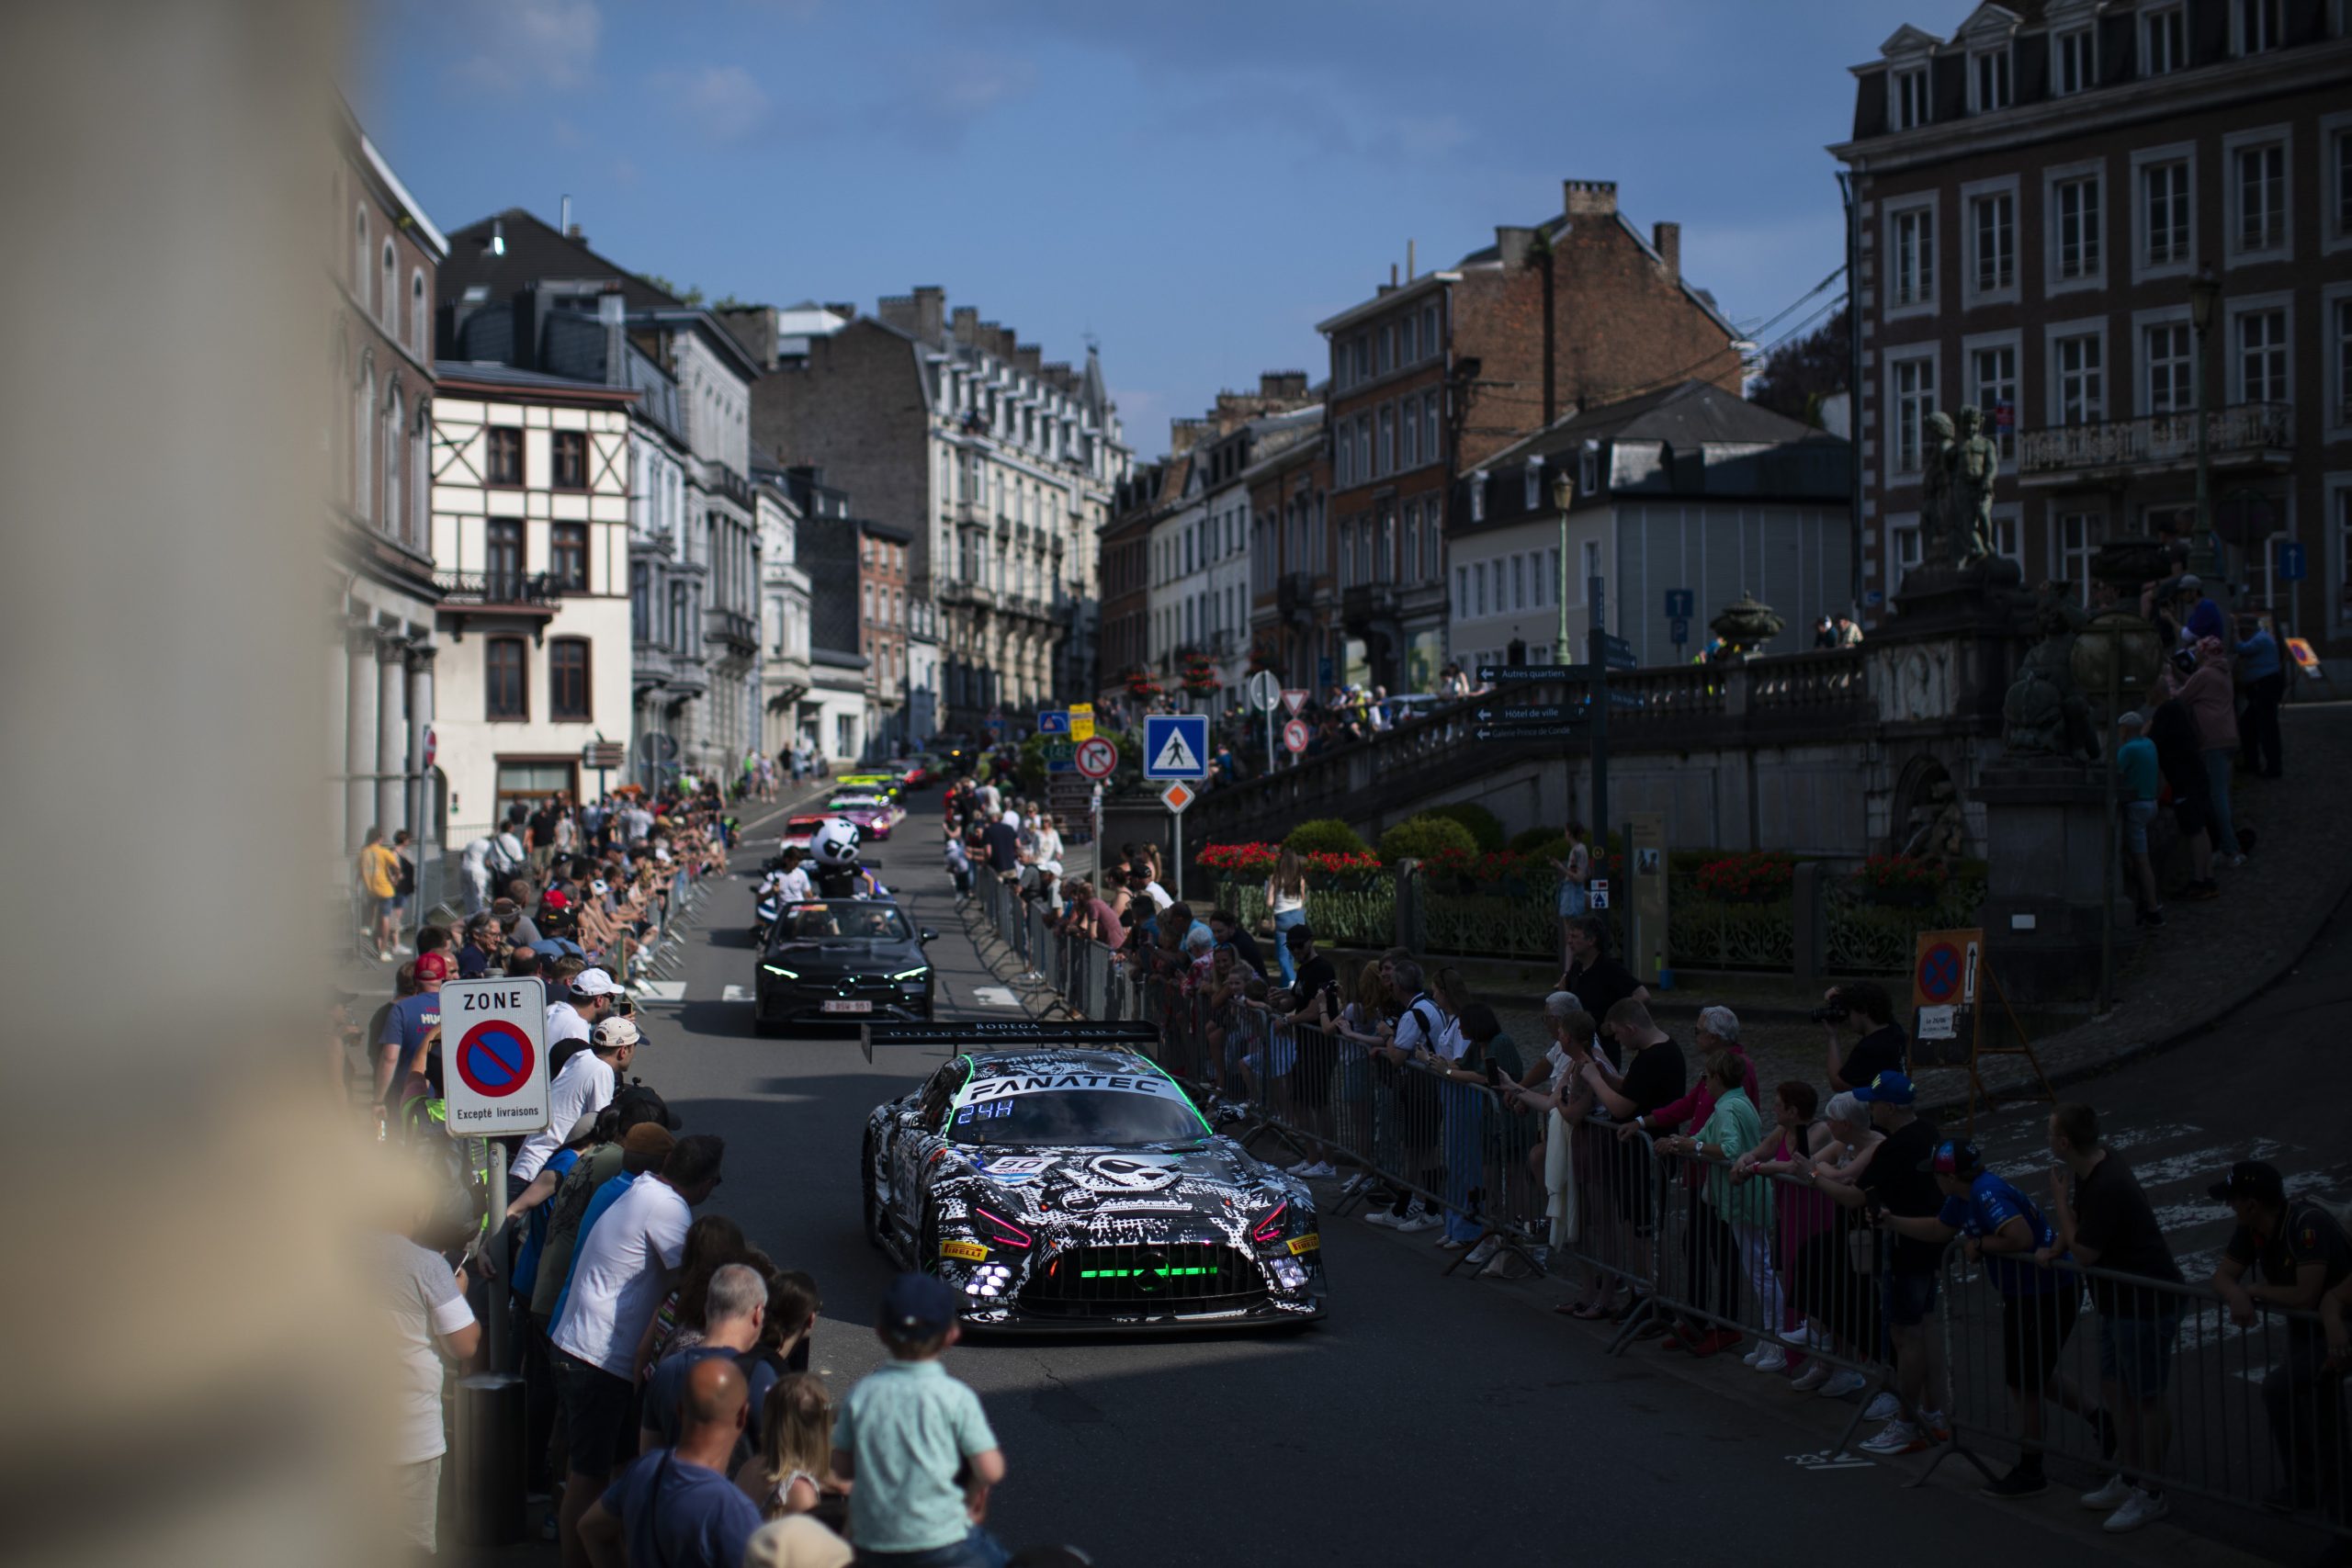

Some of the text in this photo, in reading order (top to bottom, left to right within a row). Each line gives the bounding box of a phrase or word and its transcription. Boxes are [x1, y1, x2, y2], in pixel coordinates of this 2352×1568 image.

[1501, 670, 1566, 680] Autres quartiers
[1505, 708, 1528, 718] Hôtel
[1529, 708, 1540, 717] de
[1542, 707, 1559, 716] ville
[1492, 728, 1516, 739] Galerie
[1539, 728, 1547, 736] de
[464, 991, 522, 1011] ZONE
[970, 1076, 1159, 1100] FANATEC
[458, 1106, 539, 1121] Excepté livraisons
[958, 1100, 1013, 1124] 24H
[944, 1244, 983, 1258] PIRELLI
